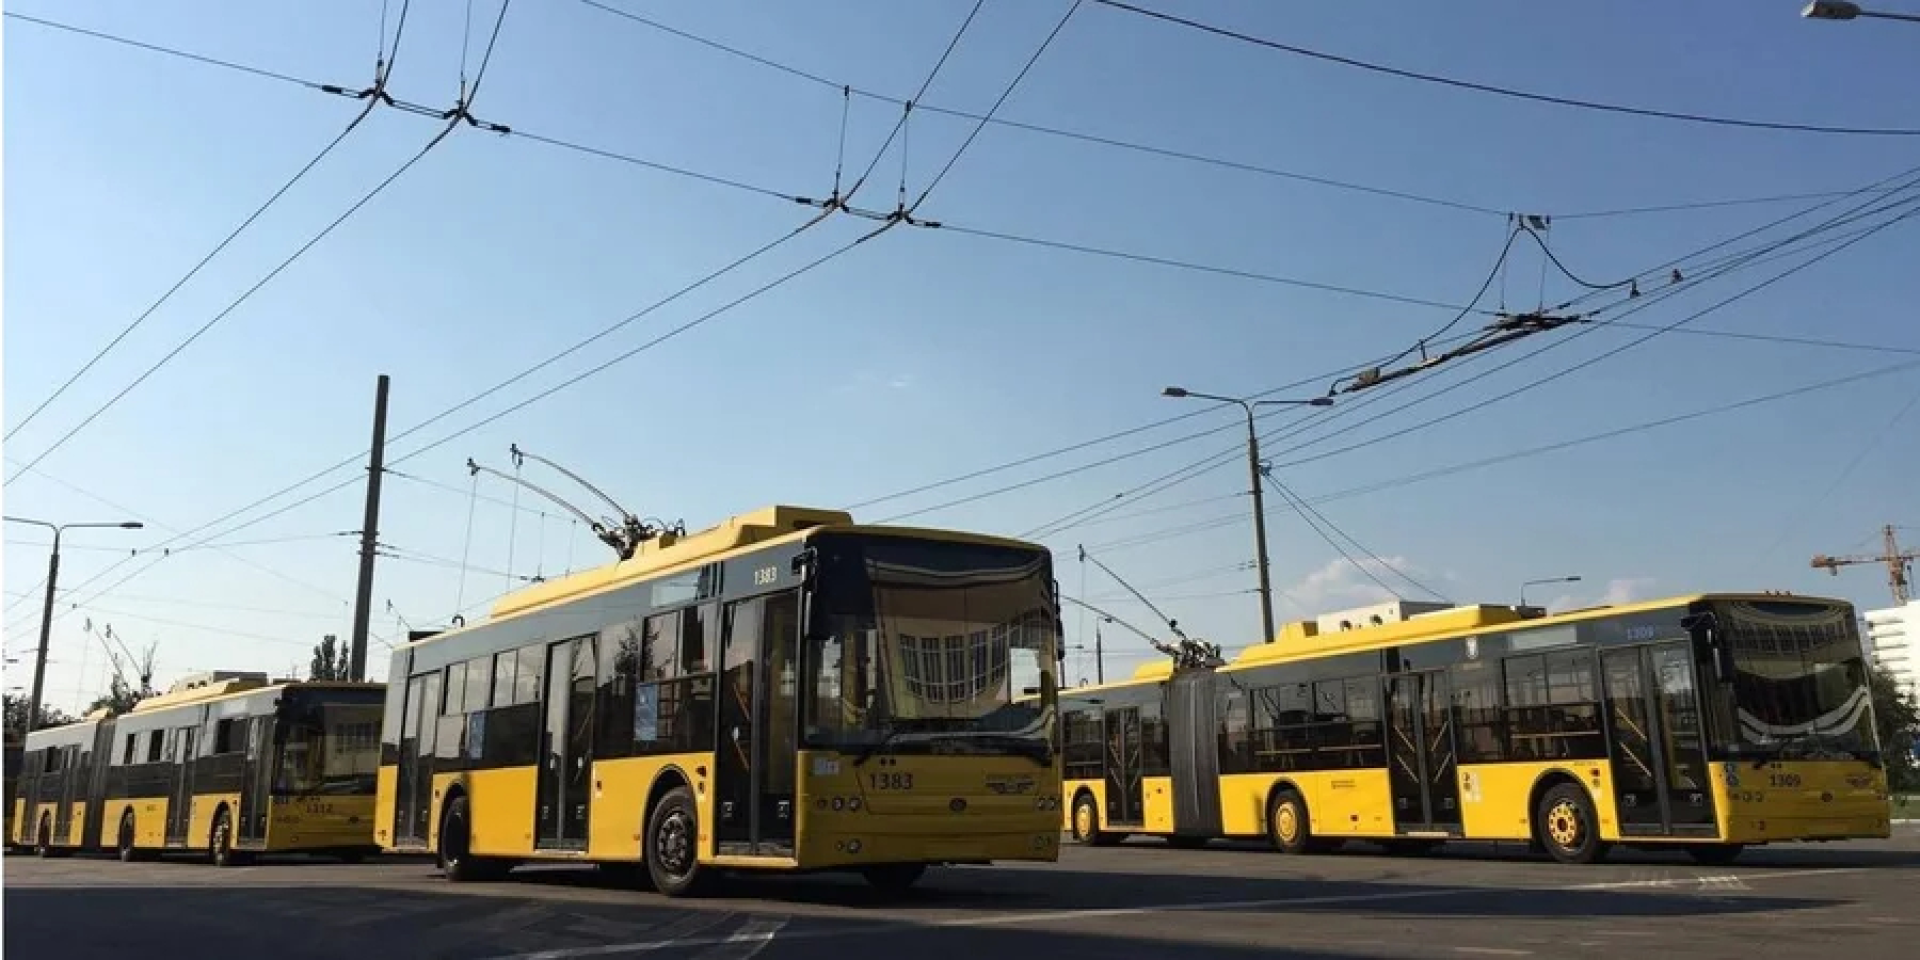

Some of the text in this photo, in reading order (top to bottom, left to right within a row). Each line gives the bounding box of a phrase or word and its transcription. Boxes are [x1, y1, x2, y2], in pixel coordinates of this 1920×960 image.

[754, 566, 777, 585] 1383
[870, 773, 913, 789] 1383
[1769, 774, 1801, 788] 1309
